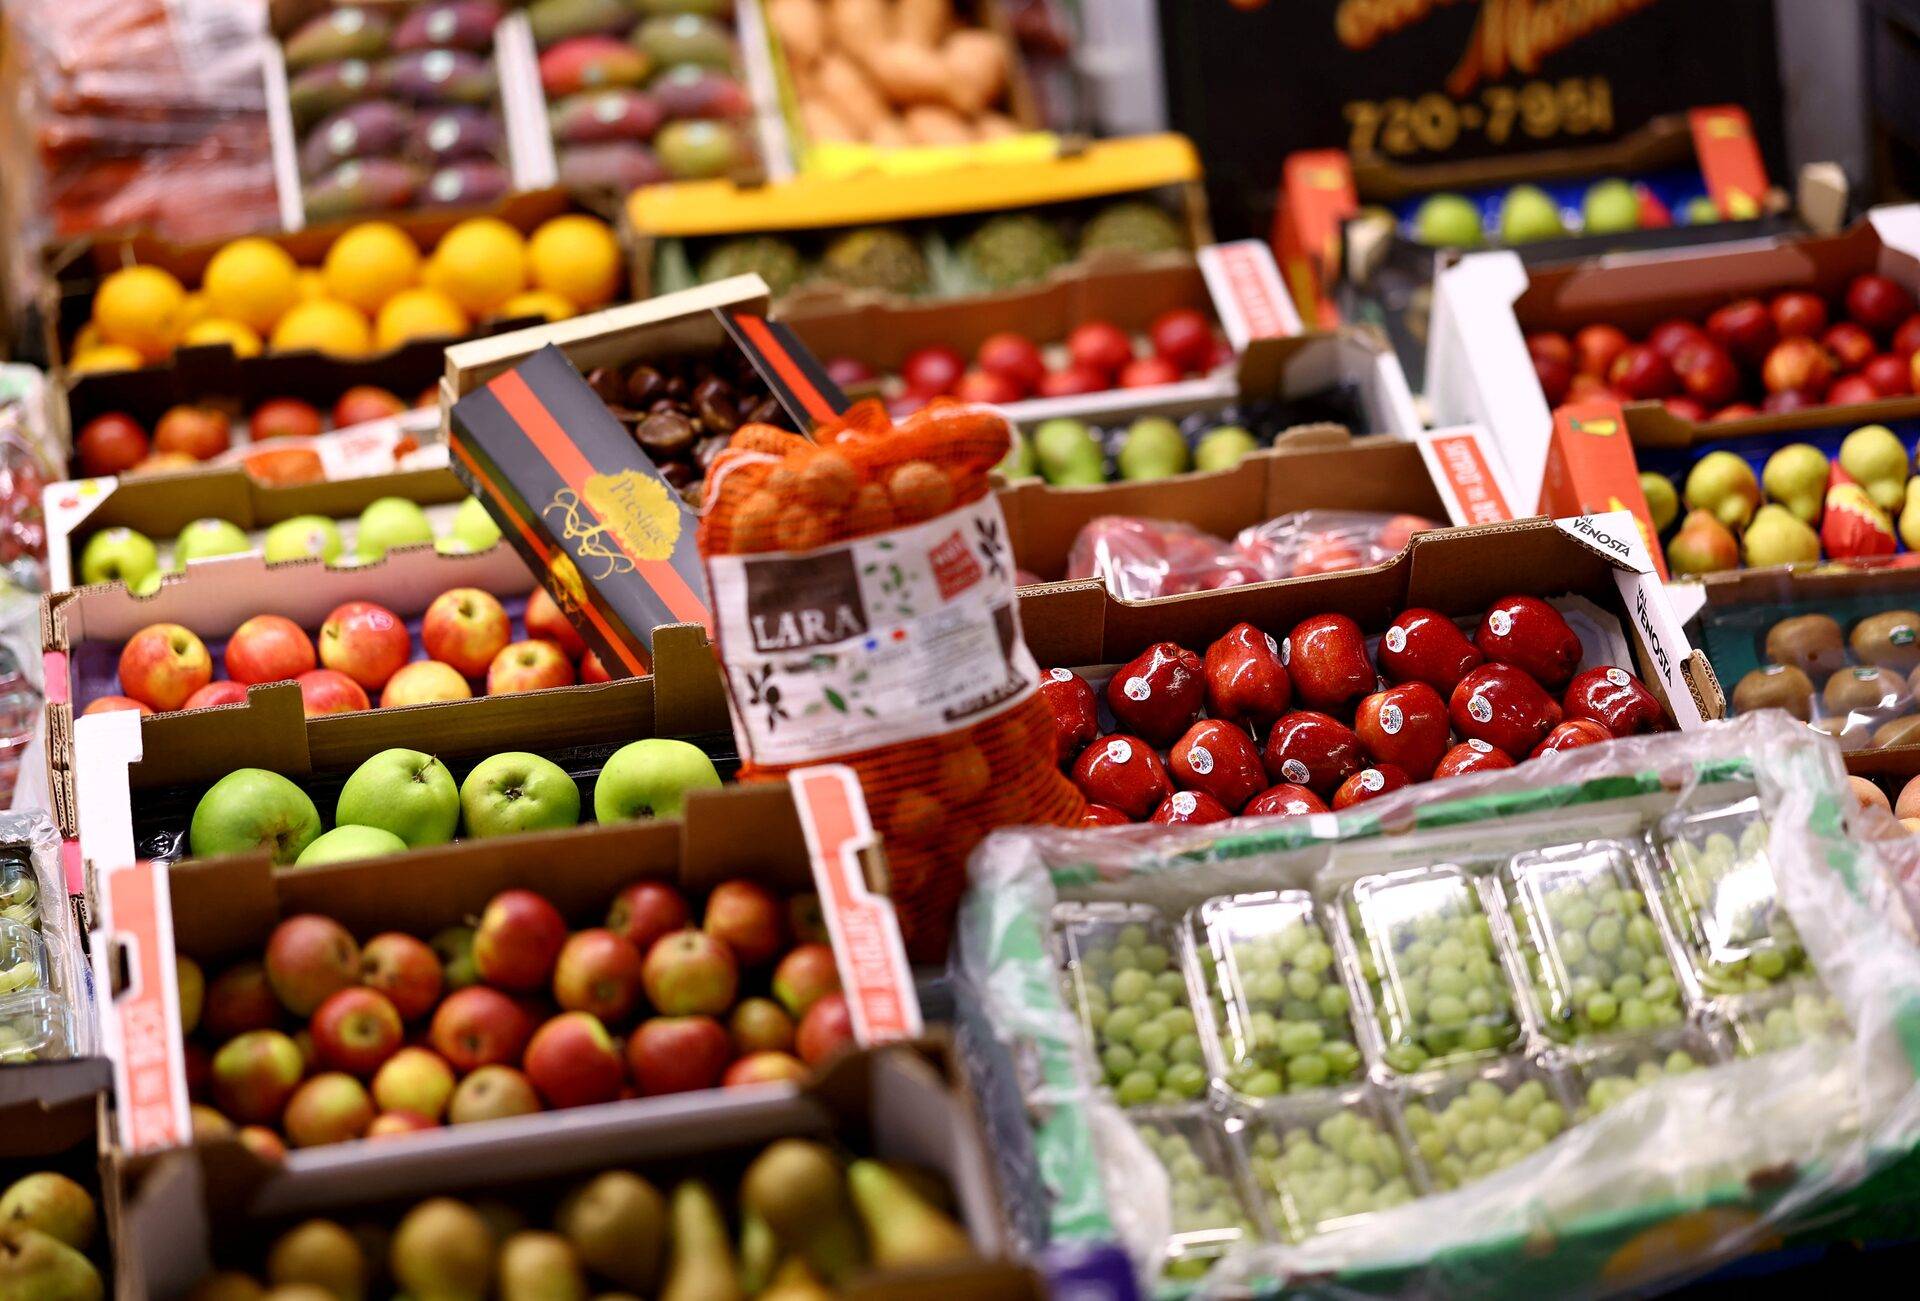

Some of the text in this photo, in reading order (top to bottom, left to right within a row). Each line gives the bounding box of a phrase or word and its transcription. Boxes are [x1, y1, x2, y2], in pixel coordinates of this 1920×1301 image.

[1573, 519, 1630, 557] VENOSTA
[752, 603, 864, 649] LARA
[1637, 593, 1671, 687] VENOSTA
